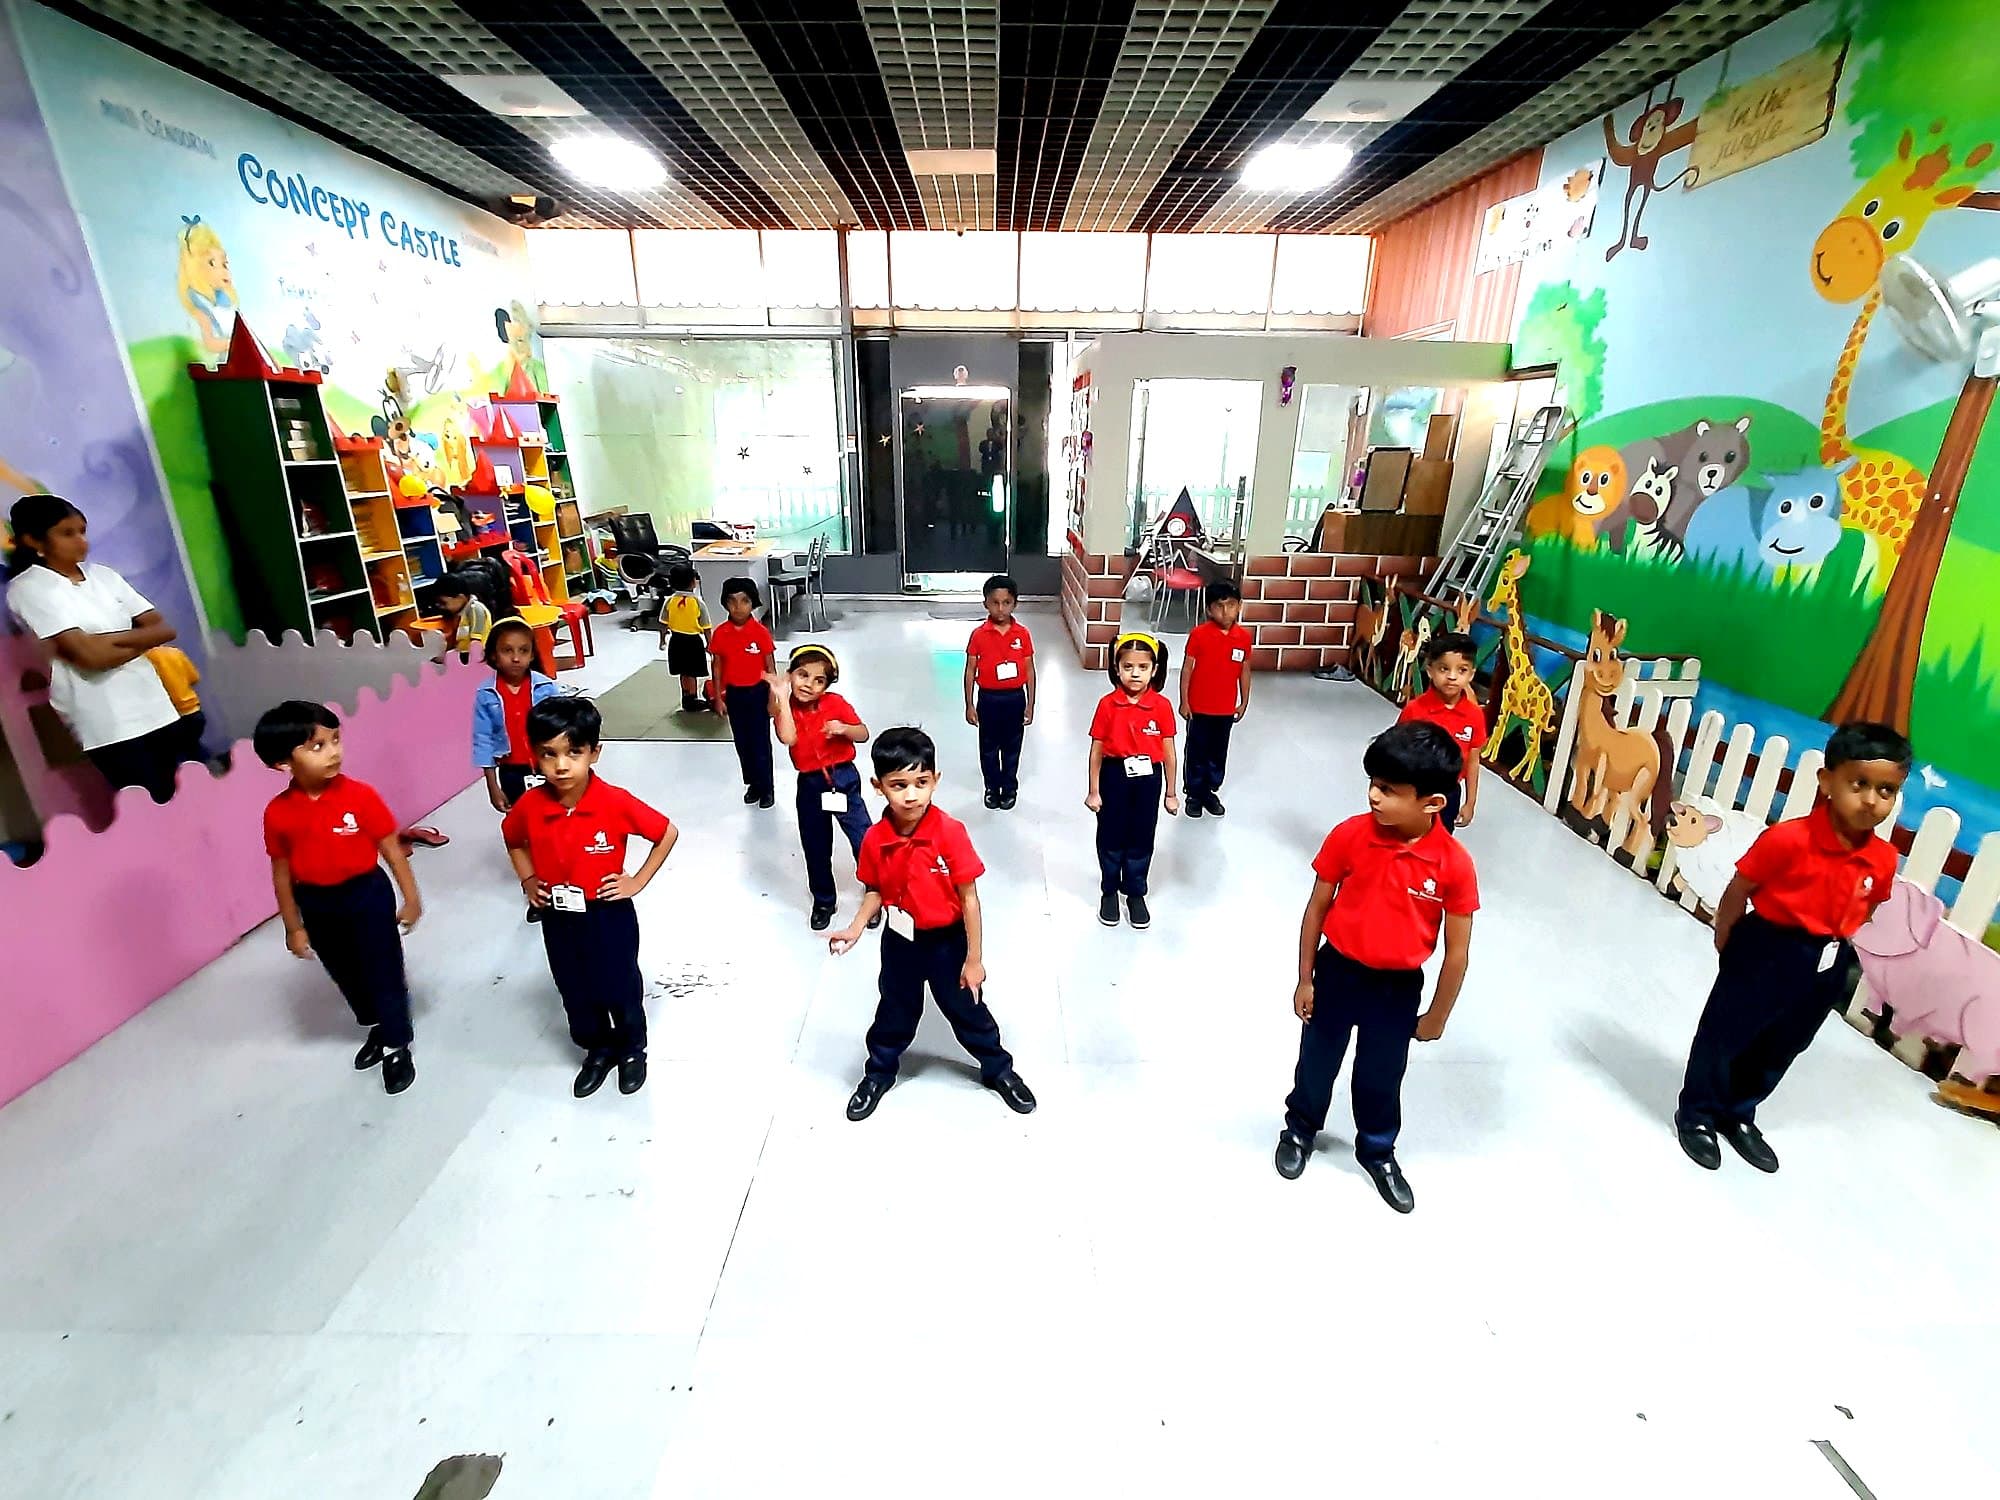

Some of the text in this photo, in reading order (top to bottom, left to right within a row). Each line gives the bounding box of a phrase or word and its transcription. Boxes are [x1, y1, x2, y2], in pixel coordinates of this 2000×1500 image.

[1754, 87, 1792, 119] the
[237, 153, 461, 268] CONCEPT CASTLE
